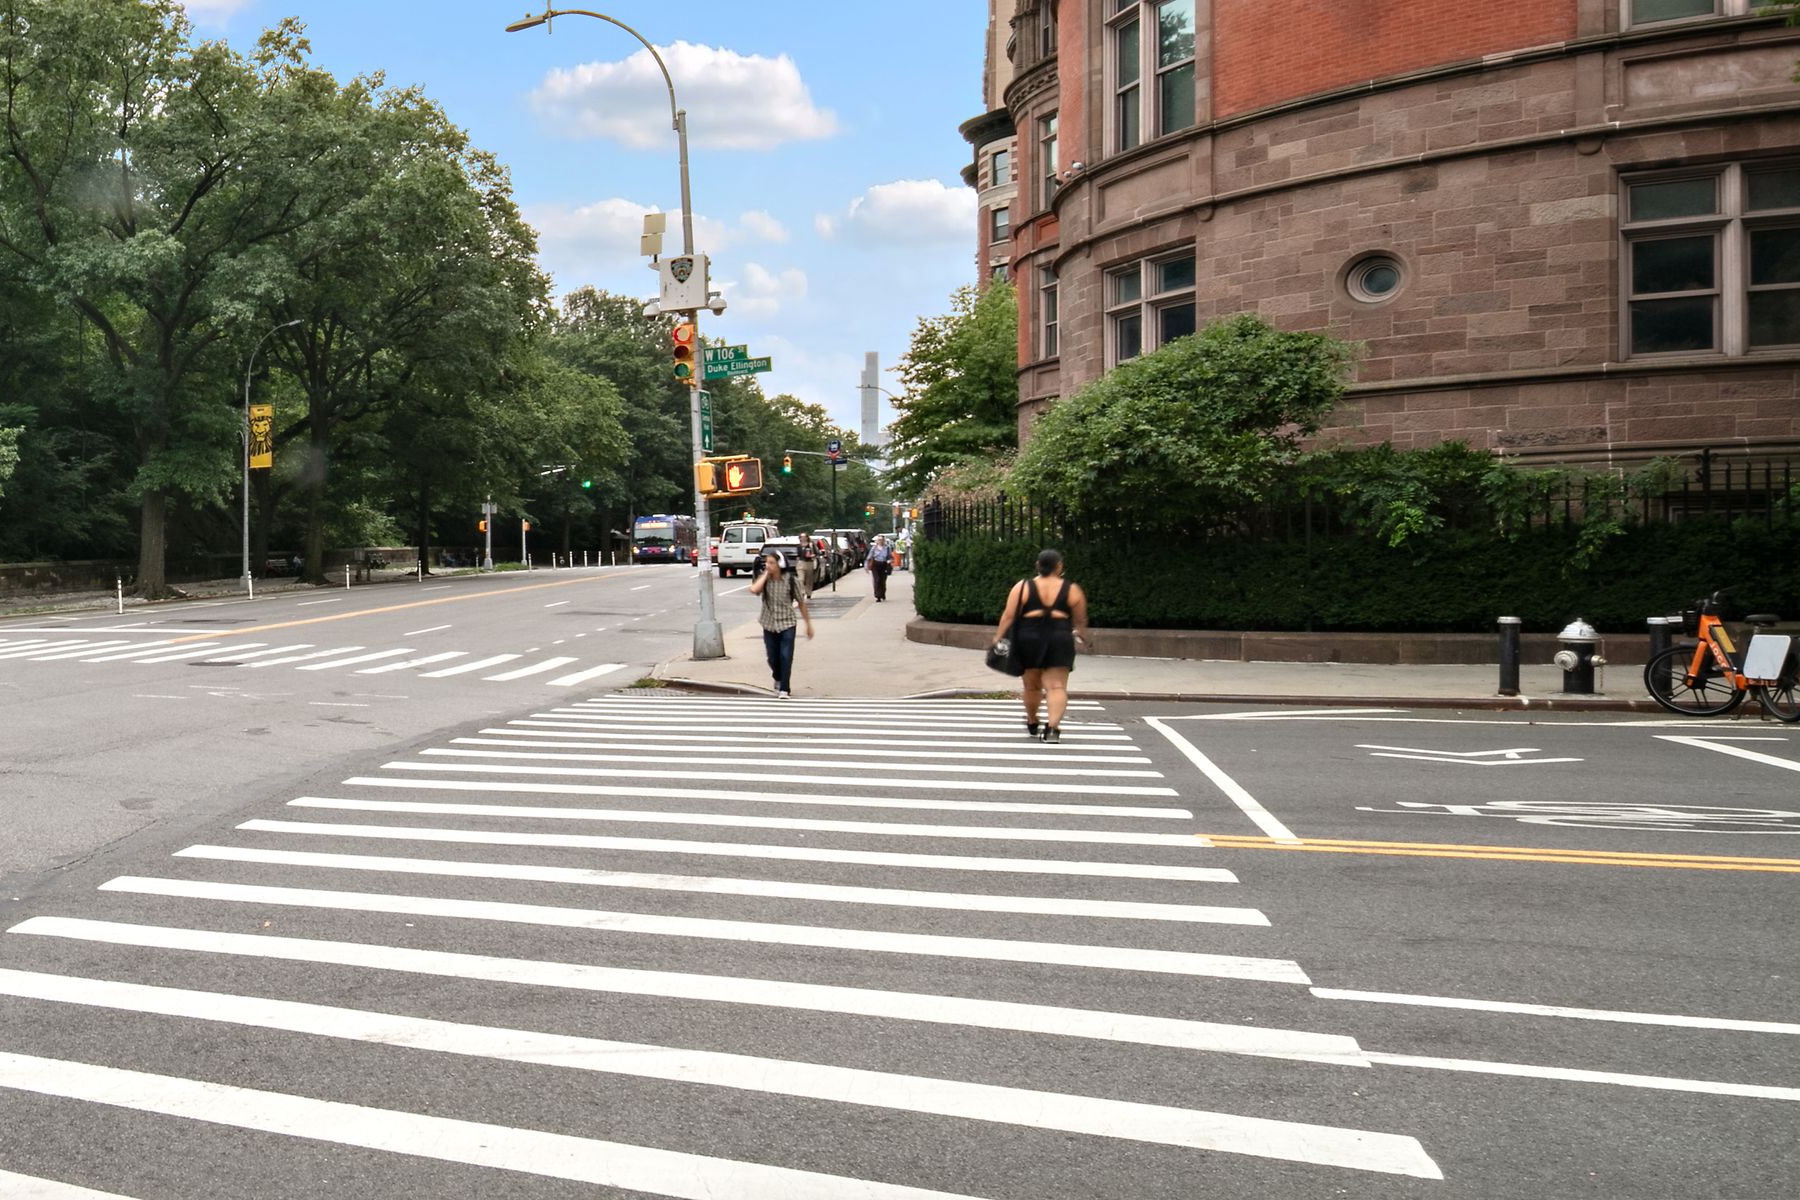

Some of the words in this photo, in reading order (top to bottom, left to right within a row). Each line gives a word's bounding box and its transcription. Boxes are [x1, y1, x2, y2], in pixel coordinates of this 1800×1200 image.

[705, 349, 714, 362] W
[717, 348, 735, 361] 106
[707, 364, 729, 374] Duke
[730, 360, 767, 371] Ellington
